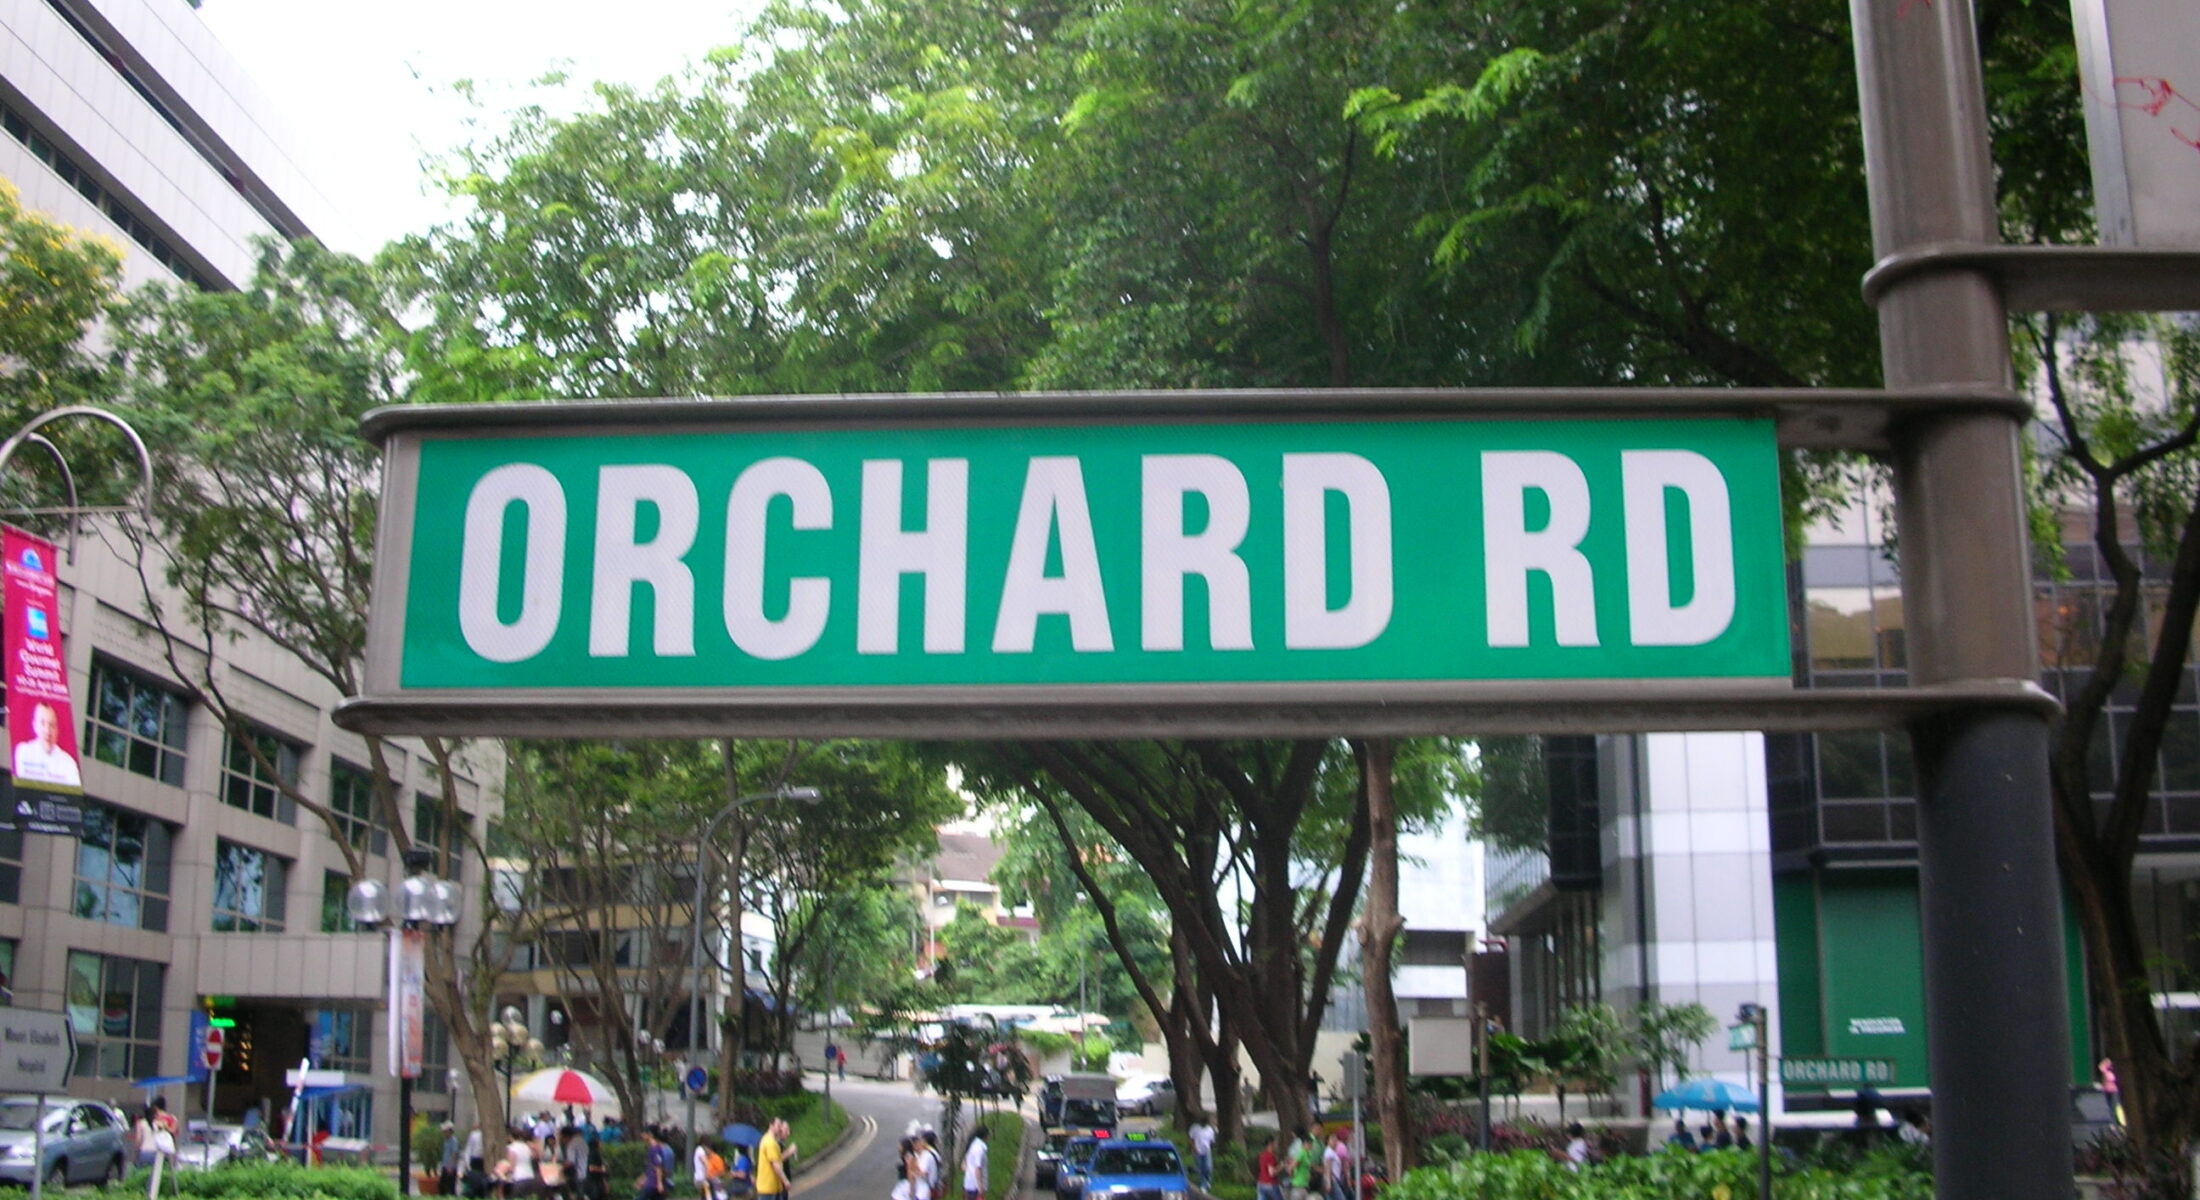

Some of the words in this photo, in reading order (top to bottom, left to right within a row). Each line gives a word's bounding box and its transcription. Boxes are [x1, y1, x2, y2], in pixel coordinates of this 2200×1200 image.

[458, 452, 1394, 662] ORCHARD
[1480, 450, 1737, 646] RD
[1784, 1060, 1861, 1081] ORCHARD
[1866, 1060, 1888, 1081] RD
